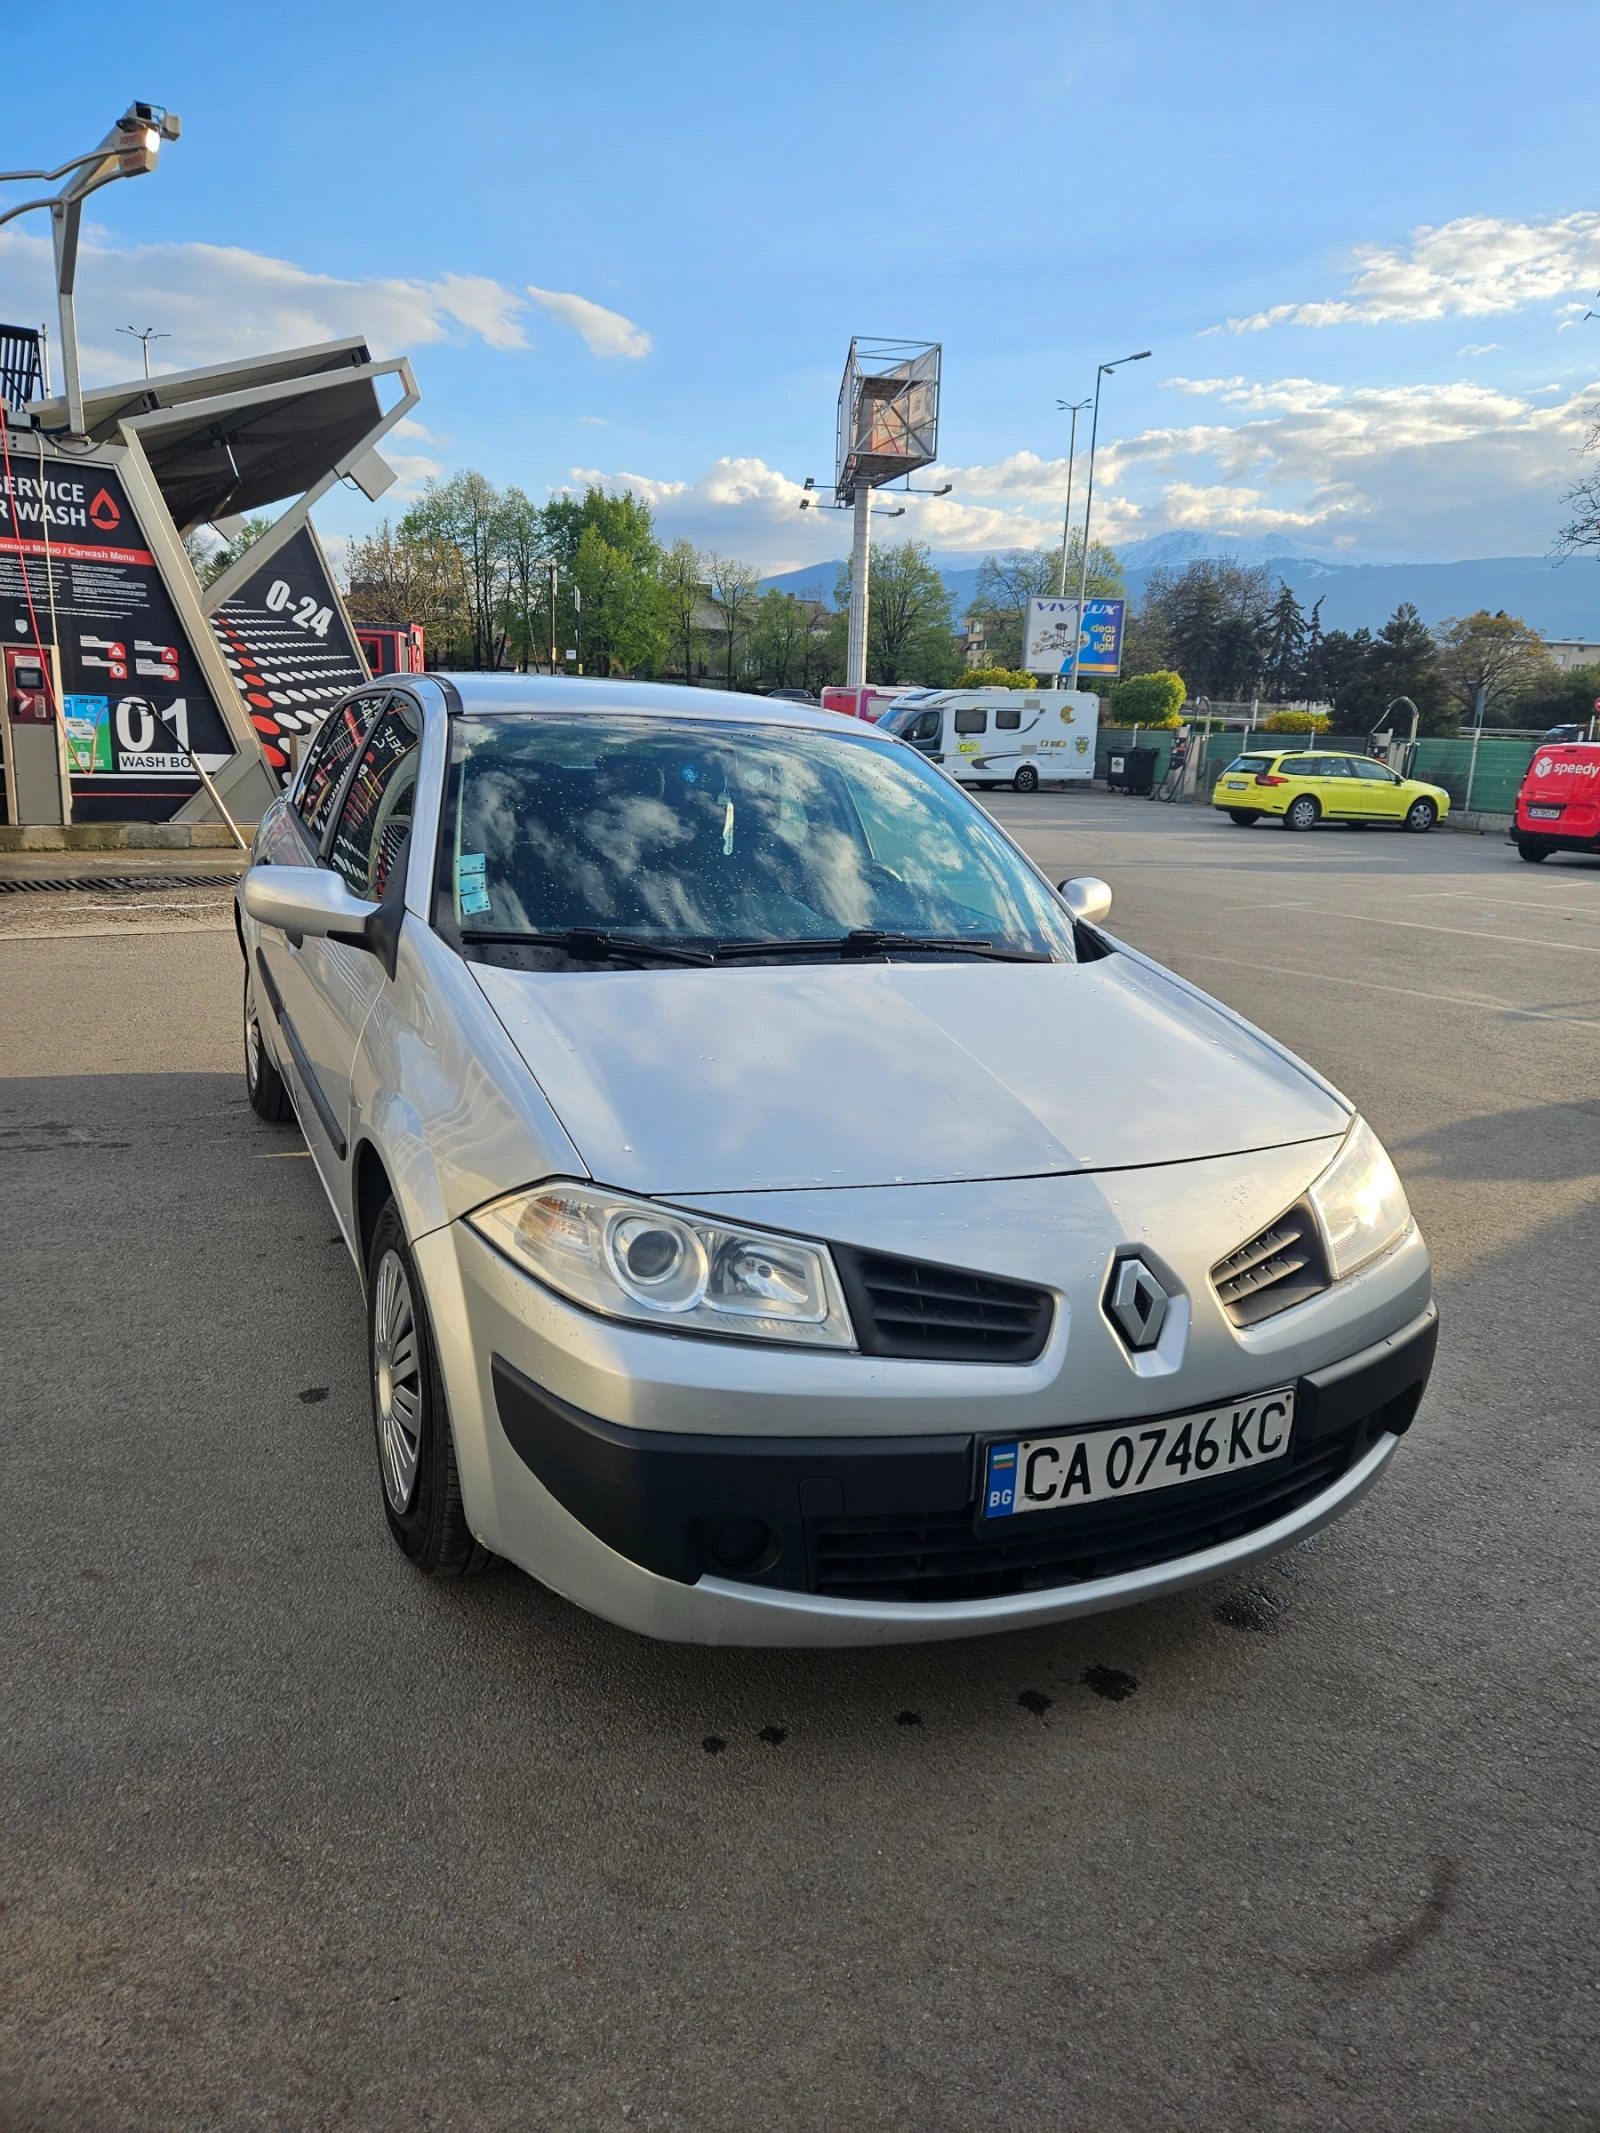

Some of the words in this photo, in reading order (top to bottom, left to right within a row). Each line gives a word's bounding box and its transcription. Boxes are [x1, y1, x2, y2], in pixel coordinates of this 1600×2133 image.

[0, 475, 85, 502] ERVICE
[15, 501, 86, 527] WASH
[68, 547, 108, 559] Carwash
[110, 552, 135, 562] Menu
[265, 579, 334, 638] 0-24
[1090, 623, 1116, 633] ideas
[1102, 633, 1115, 642] for
[1093, 641, 1115, 653] light
[115, 696, 190, 753] 01
[121, 756, 166, 768] WASH
[170, 757, 200, 768] BO
[1553, 762, 1600, 778] speedy
[990, 1489, 1012, 1507] BG
